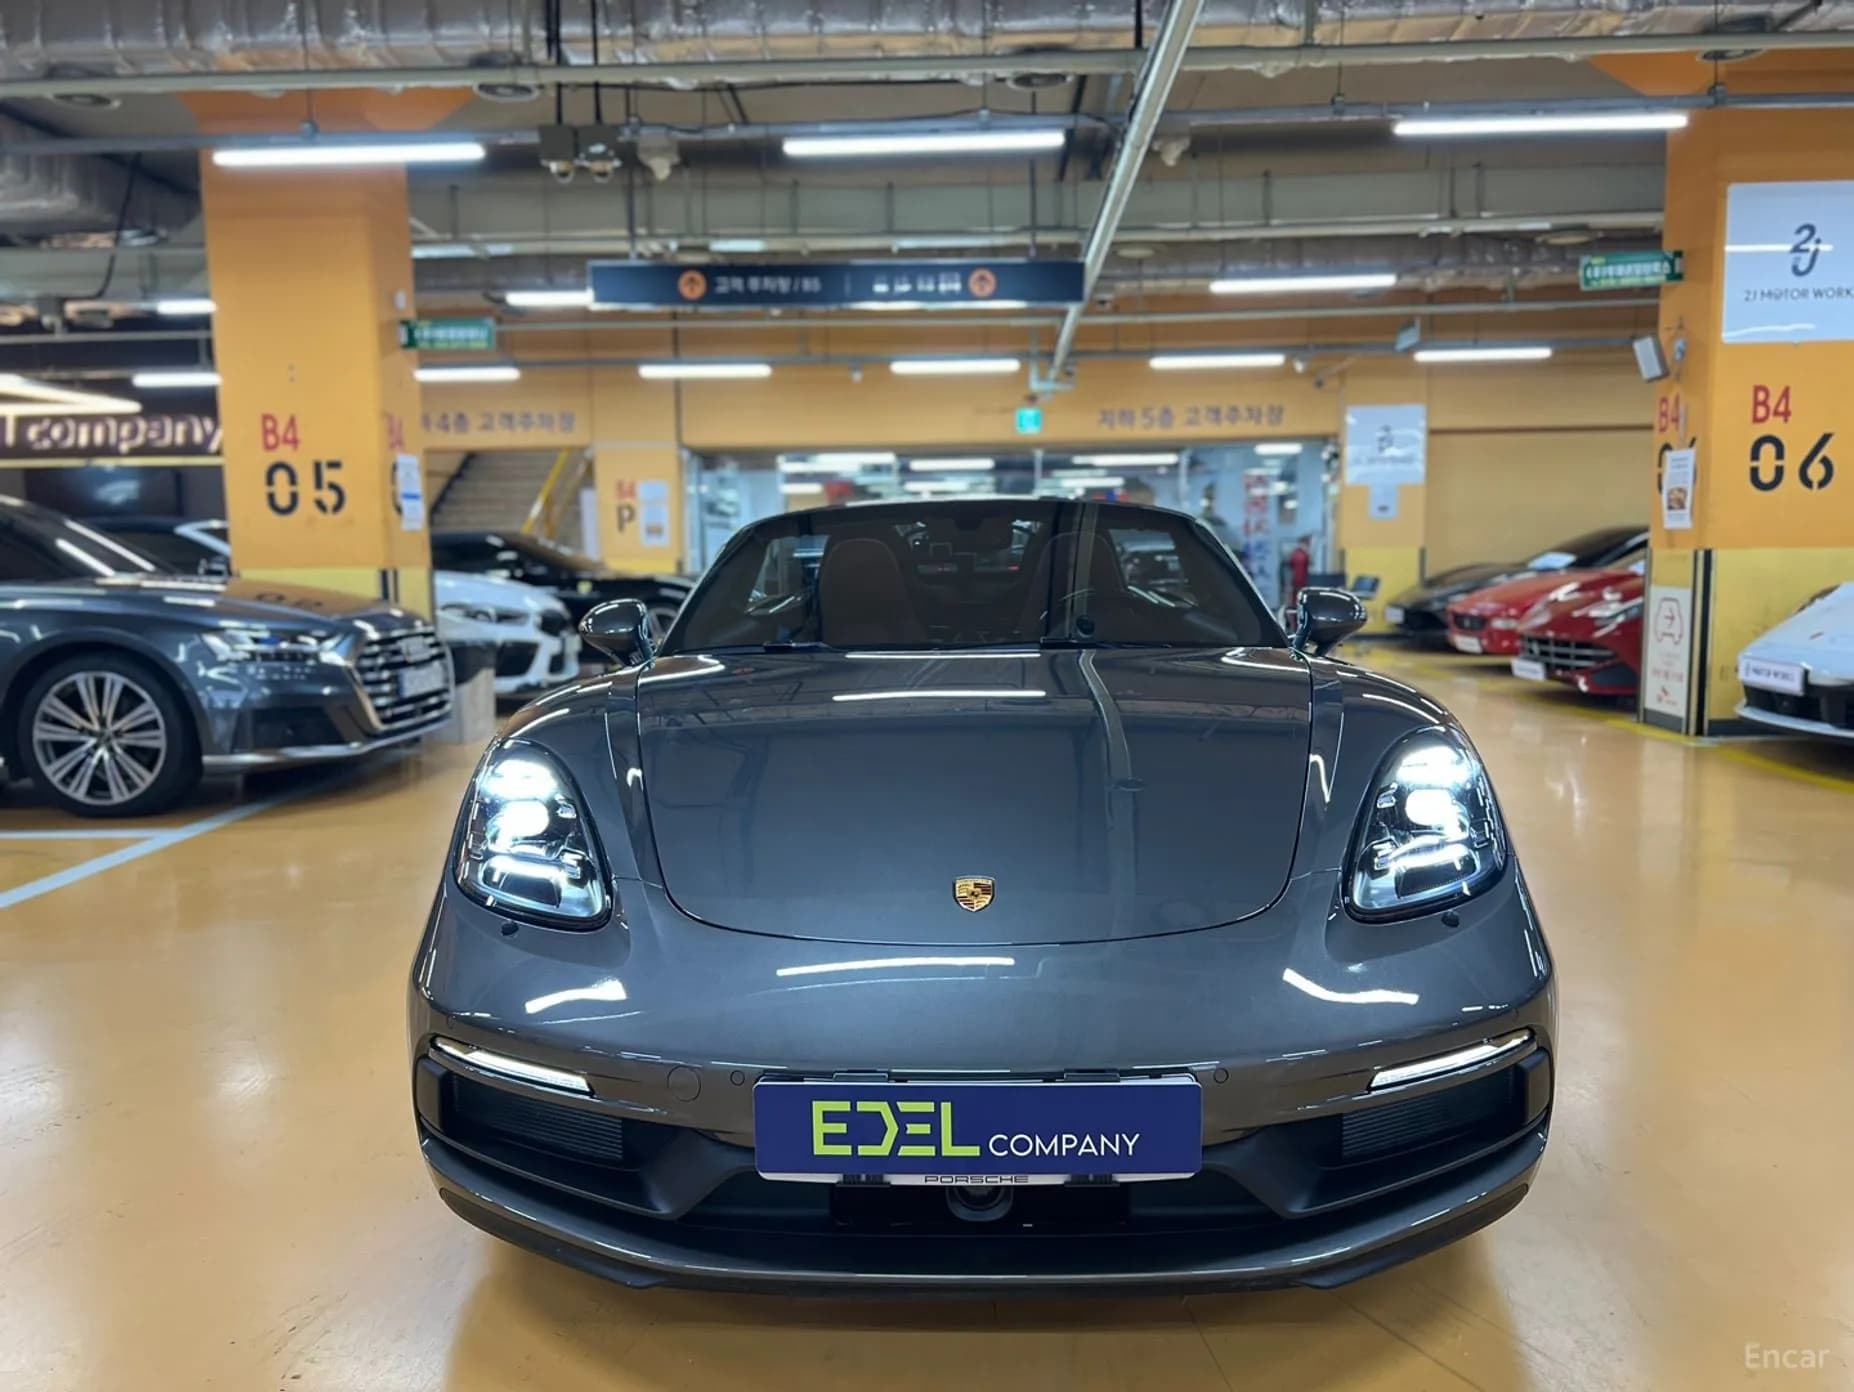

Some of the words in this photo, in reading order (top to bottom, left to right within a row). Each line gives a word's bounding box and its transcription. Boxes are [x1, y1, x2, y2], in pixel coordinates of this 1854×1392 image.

[1760, 288, 1810, 301] MOTOR
[1658, 393, 1681, 434] B4
[1752, 384, 1792, 425] B4
[27, 416, 223, 454] company
[261, 414, 299, 451] B4
[1750, 432, 1835, 492] 06
[265, 461, 345, 516] 05
[617, 503, 635, 533] P
[812, 1101, 980, 1156] EDEL
[988, 1133, 1141, 1157] COMPANY
[924, 1175, 1029, 1184] PORSCHE
